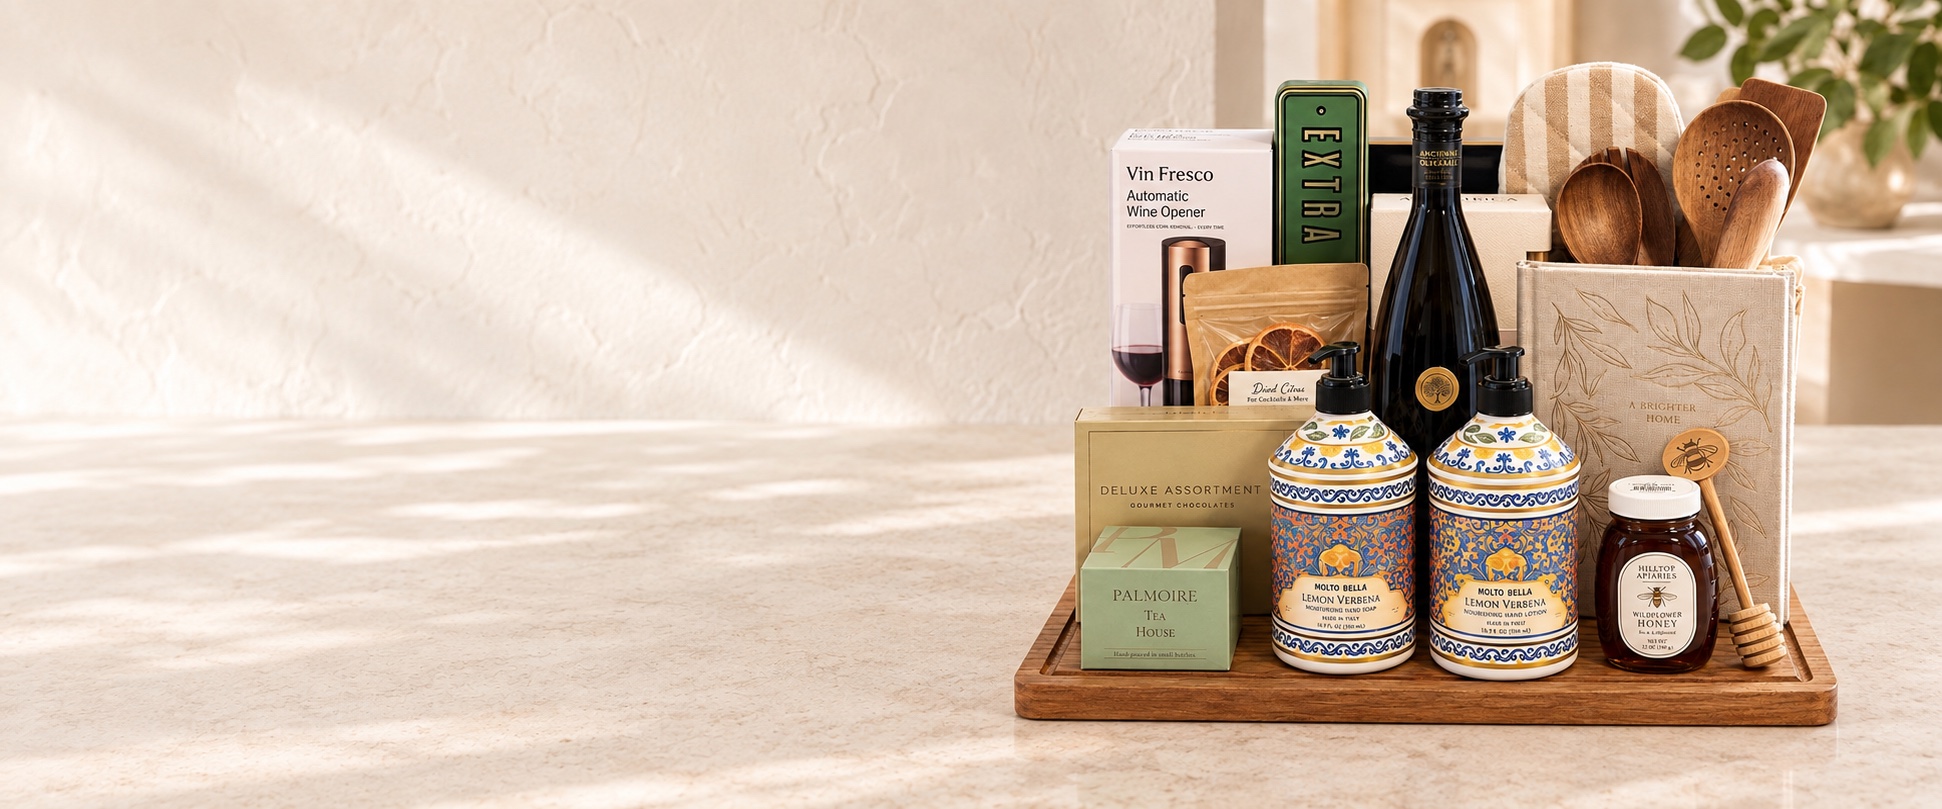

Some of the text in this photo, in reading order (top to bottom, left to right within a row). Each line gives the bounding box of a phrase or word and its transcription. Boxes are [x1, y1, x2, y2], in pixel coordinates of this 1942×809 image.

[1126, 166, 1214, 181] Vin Fresco
[1302, 127, 1342, 244] EXTRA
[1126, 190, 1189, 201] Automatic
[1126, 205, 1206, 220] Wine Opener
[1629, 401, 1697, 412] A BRIGHTER
[1646, 414, 1681, 424] HOME
[1100, 485, 1262, 496] DELUXE ASSORTMENT
[1314, 583, 1368, 592] MOLTO BELLA
[1478, 588, 1533, 597] MOLTO BELLA
[1112, 589, 1198, 602] PALMOIRE
[1524, 609, 1548, 618] LOTION
[1637, 620, 1678, 628] HONEY
